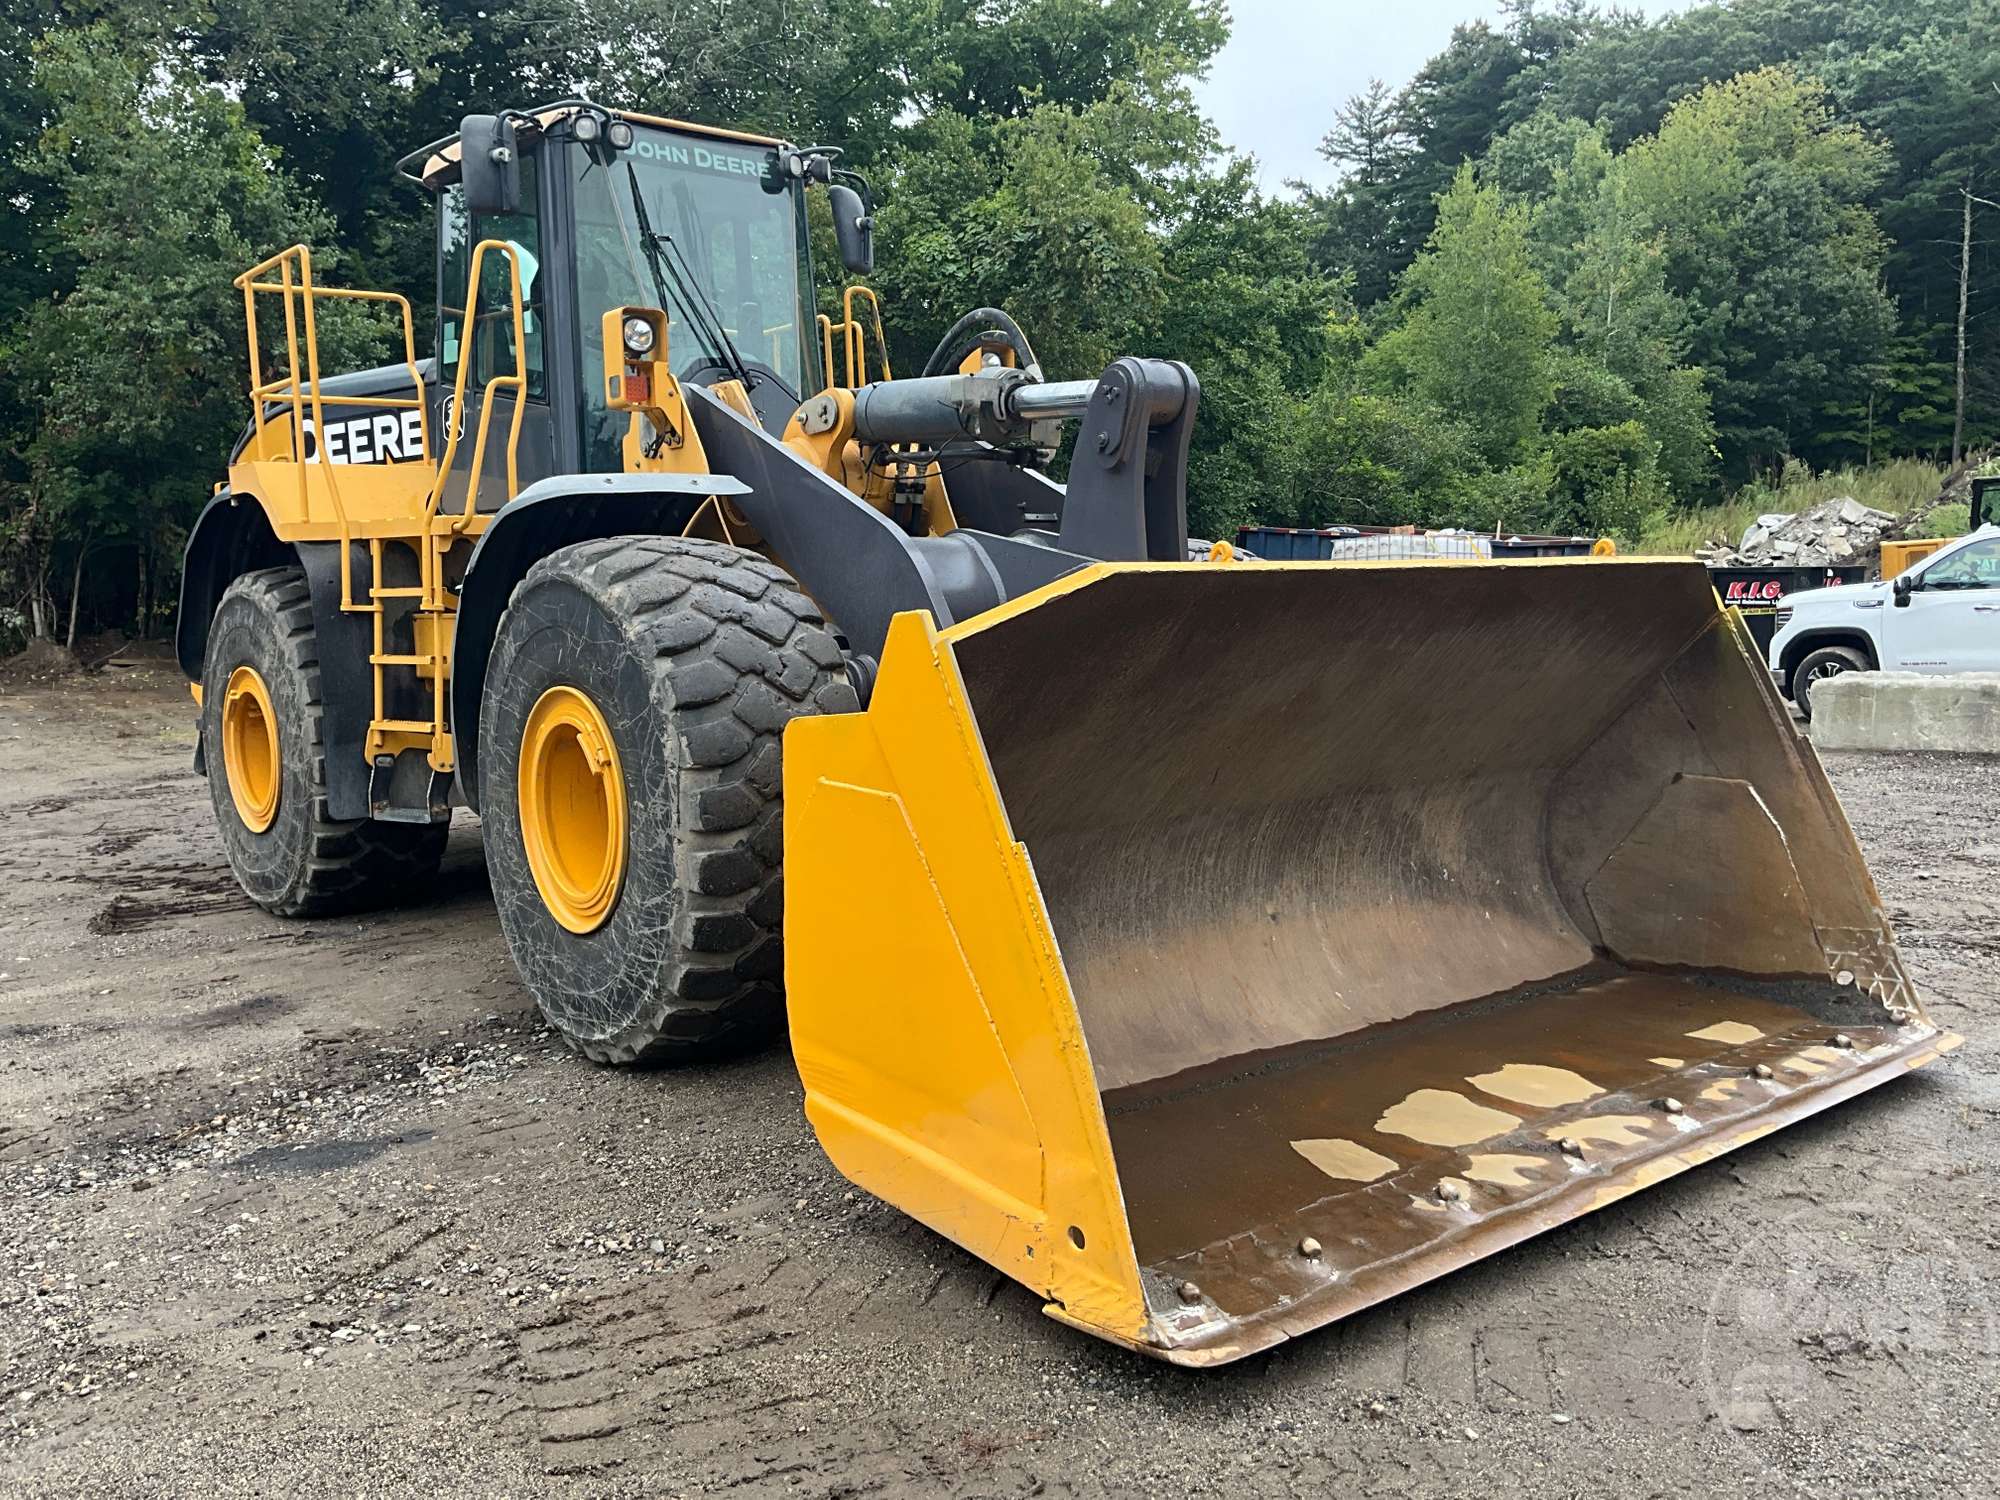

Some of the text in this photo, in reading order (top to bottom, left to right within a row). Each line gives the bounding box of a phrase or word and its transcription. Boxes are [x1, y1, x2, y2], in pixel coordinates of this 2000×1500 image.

[624, 141, 772, 179] JOHN DEERE
[301, 410, 424, 465] DEERE
[1726, 581, 1784, 599] K.I.G.
